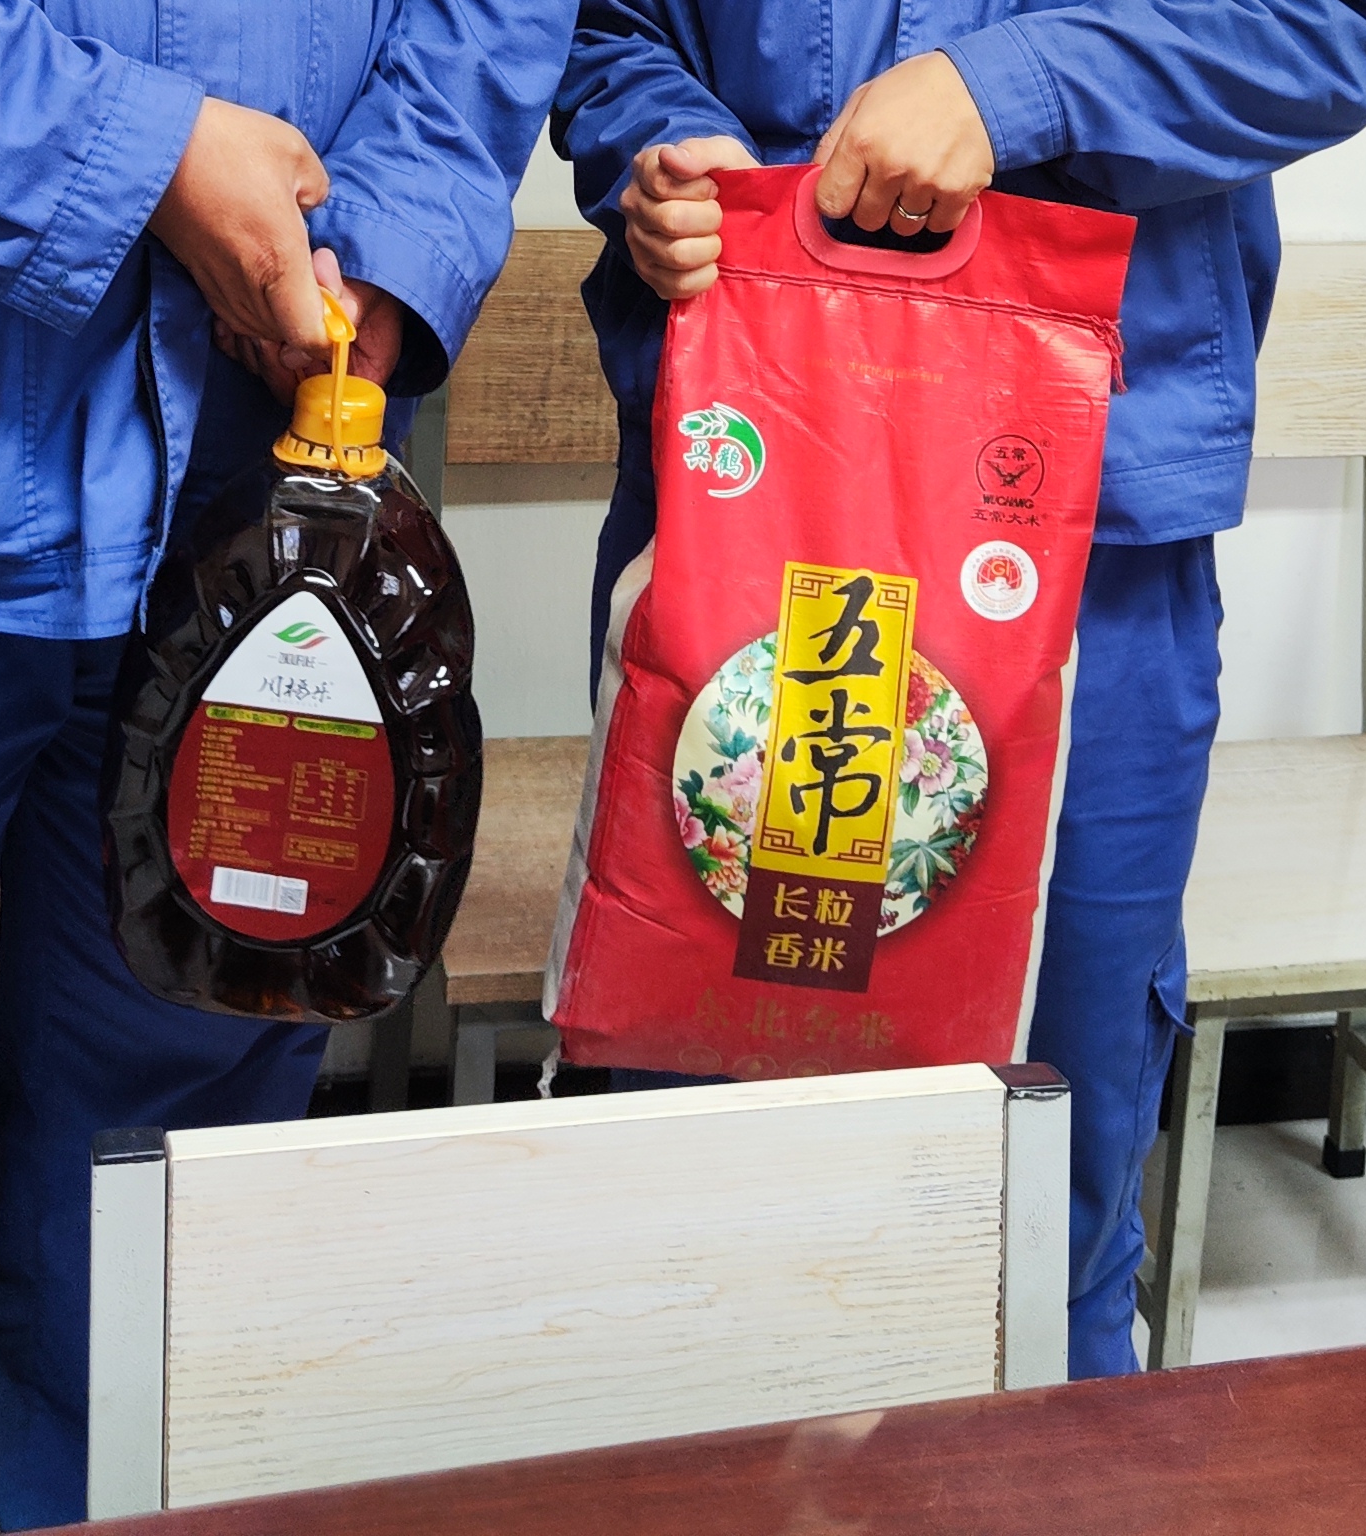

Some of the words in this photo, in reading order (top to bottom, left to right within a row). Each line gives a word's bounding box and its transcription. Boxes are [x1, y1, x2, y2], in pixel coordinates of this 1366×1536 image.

[993, 446, 1027, 462] 五常
[781, 575, 894, 857] 五常
[772, 881, 856, 929] 长粒
[763, 931, 848, 973] 香米
